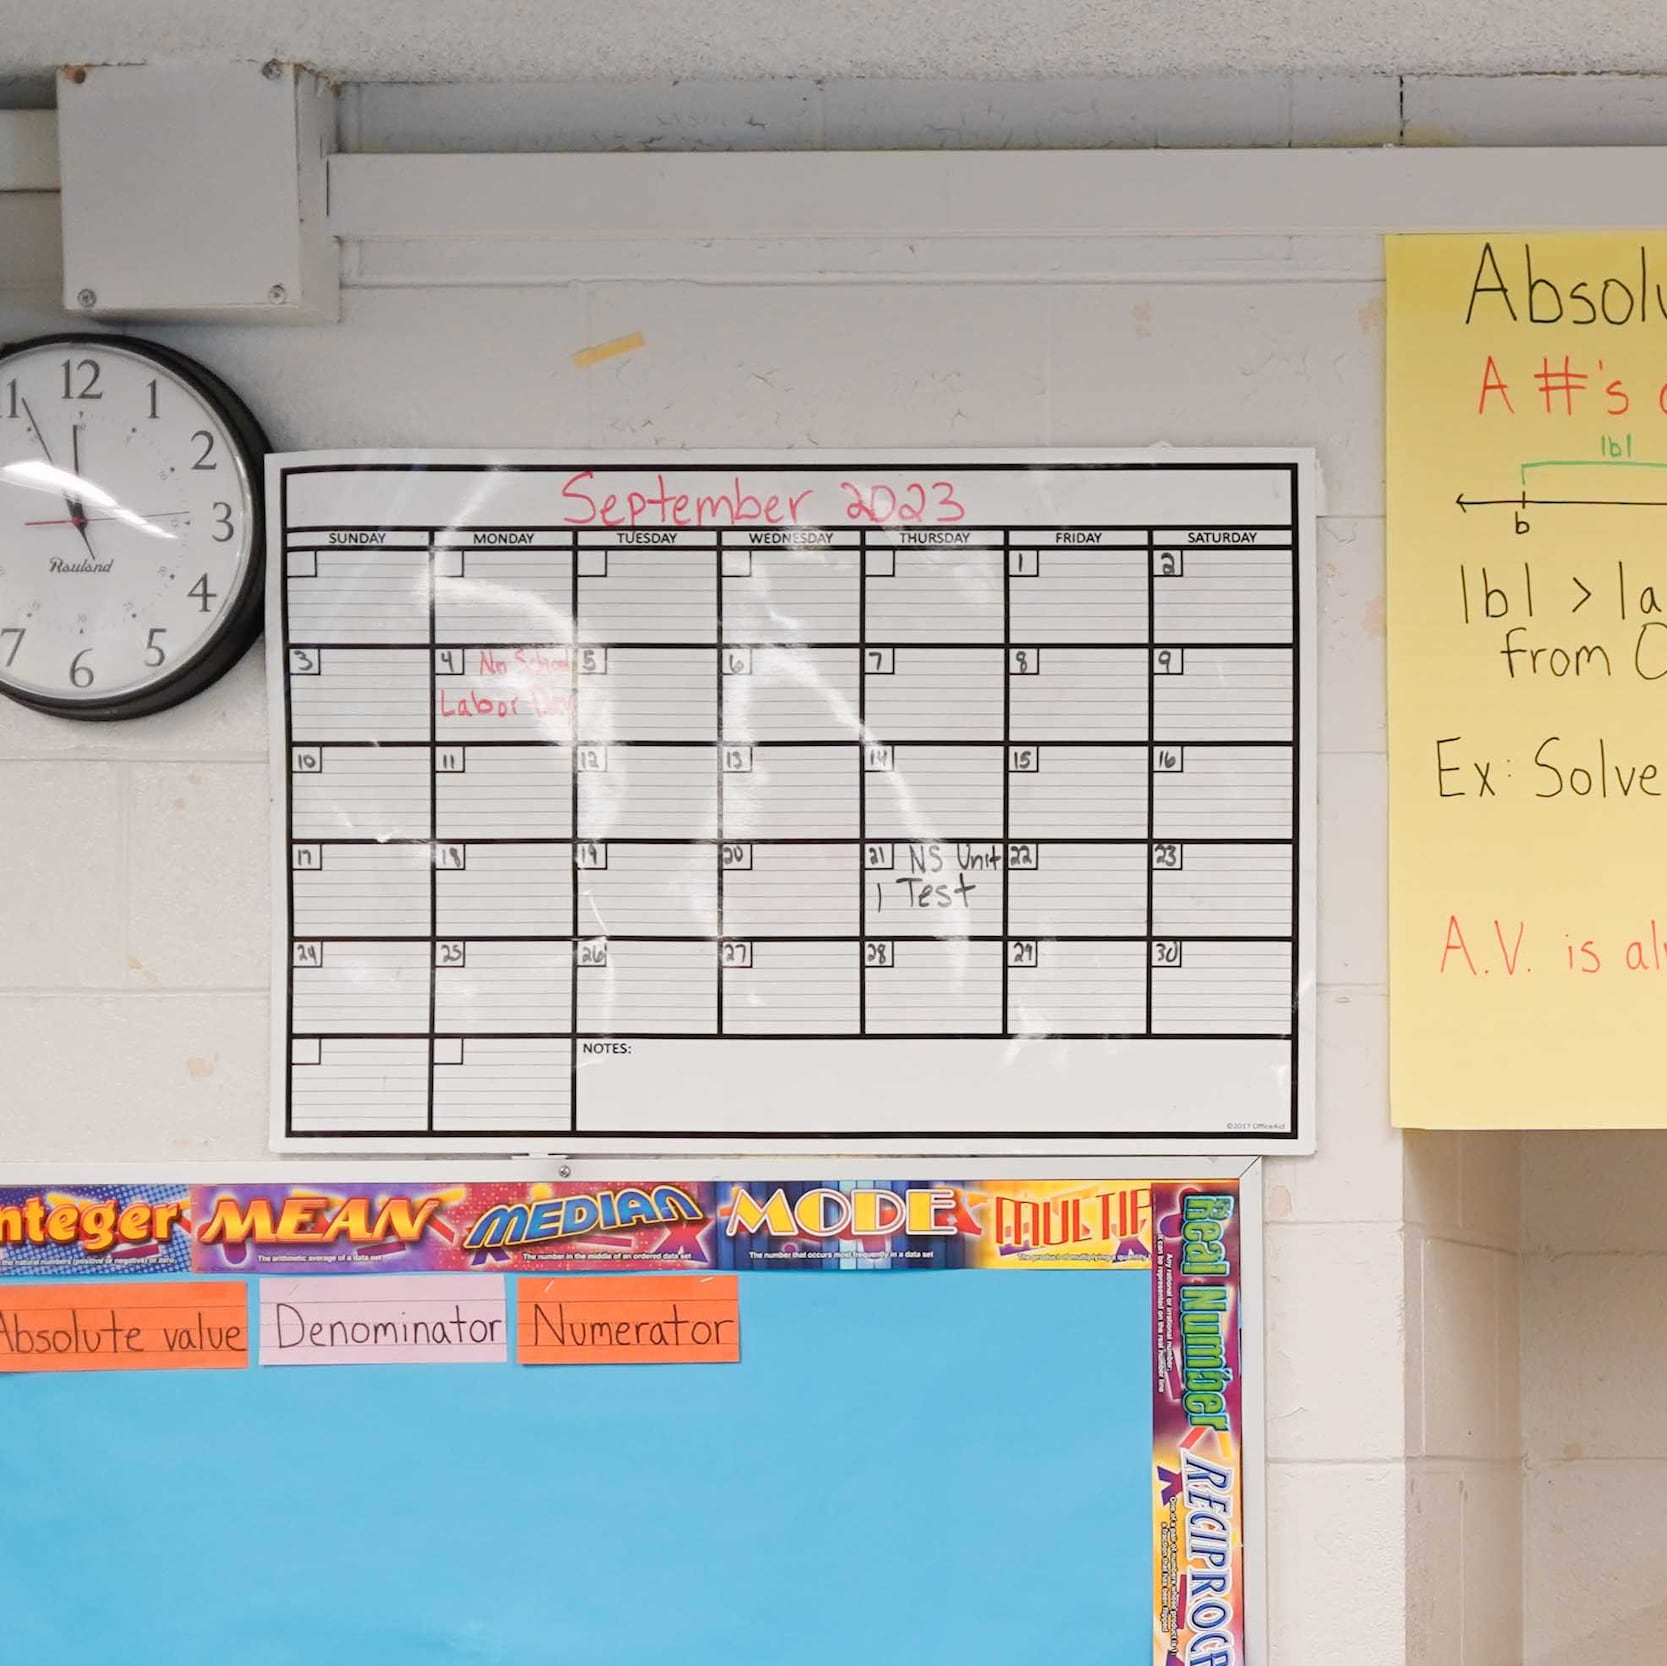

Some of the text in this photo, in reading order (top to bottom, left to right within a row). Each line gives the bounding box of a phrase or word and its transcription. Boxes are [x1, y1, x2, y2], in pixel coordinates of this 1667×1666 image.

[60, 358, 104, 400] 12
[1478, 355, 1515, 416] A
[190, 429, 217, 471] 2
[211, 501, 235, 543] 3
[562, 470, 967, 540] September 2023
[1514, 510, 1530, 534] b
[328, 531, 387, 546] SUNDAY
[473, 531, 535, 546] MONDAY
[616, 531, 678, 546] TUESDAY
[749, 531, 834, 546] WEDNESDAY
[899, 531, 971, 546] THURSDAY
[1055, 531, 1103, 546] FRIDAY
[1187, 531, 1258, 546] SATURDAY
[187, 571, 217, 613] 4
[69, 648, 95, 688] 6
[145, 627, 168, 668] 5
[1500, 626, 1612, 679] from
[1535, 736, 1662, 800] Solve
[908, 843, 1002, 875] NS Unit
[896, 872, 977, 910] Test
[1567, 933, 1602, 975] is
[582, 1043, 632, 1055] NOTES:
[198, 1195, 440, 1250] MEAN
[463, 1184, 704, 1251] MEDIAN
[727, 1187, 960, 1240] MODE
[164, 1311, 247, 1354] value
[277, 1302, 503, 1351] Denominator
[533, 1303, 738, 1347] Numerator
[1178, 1194, 1235, 1432] Real Number
